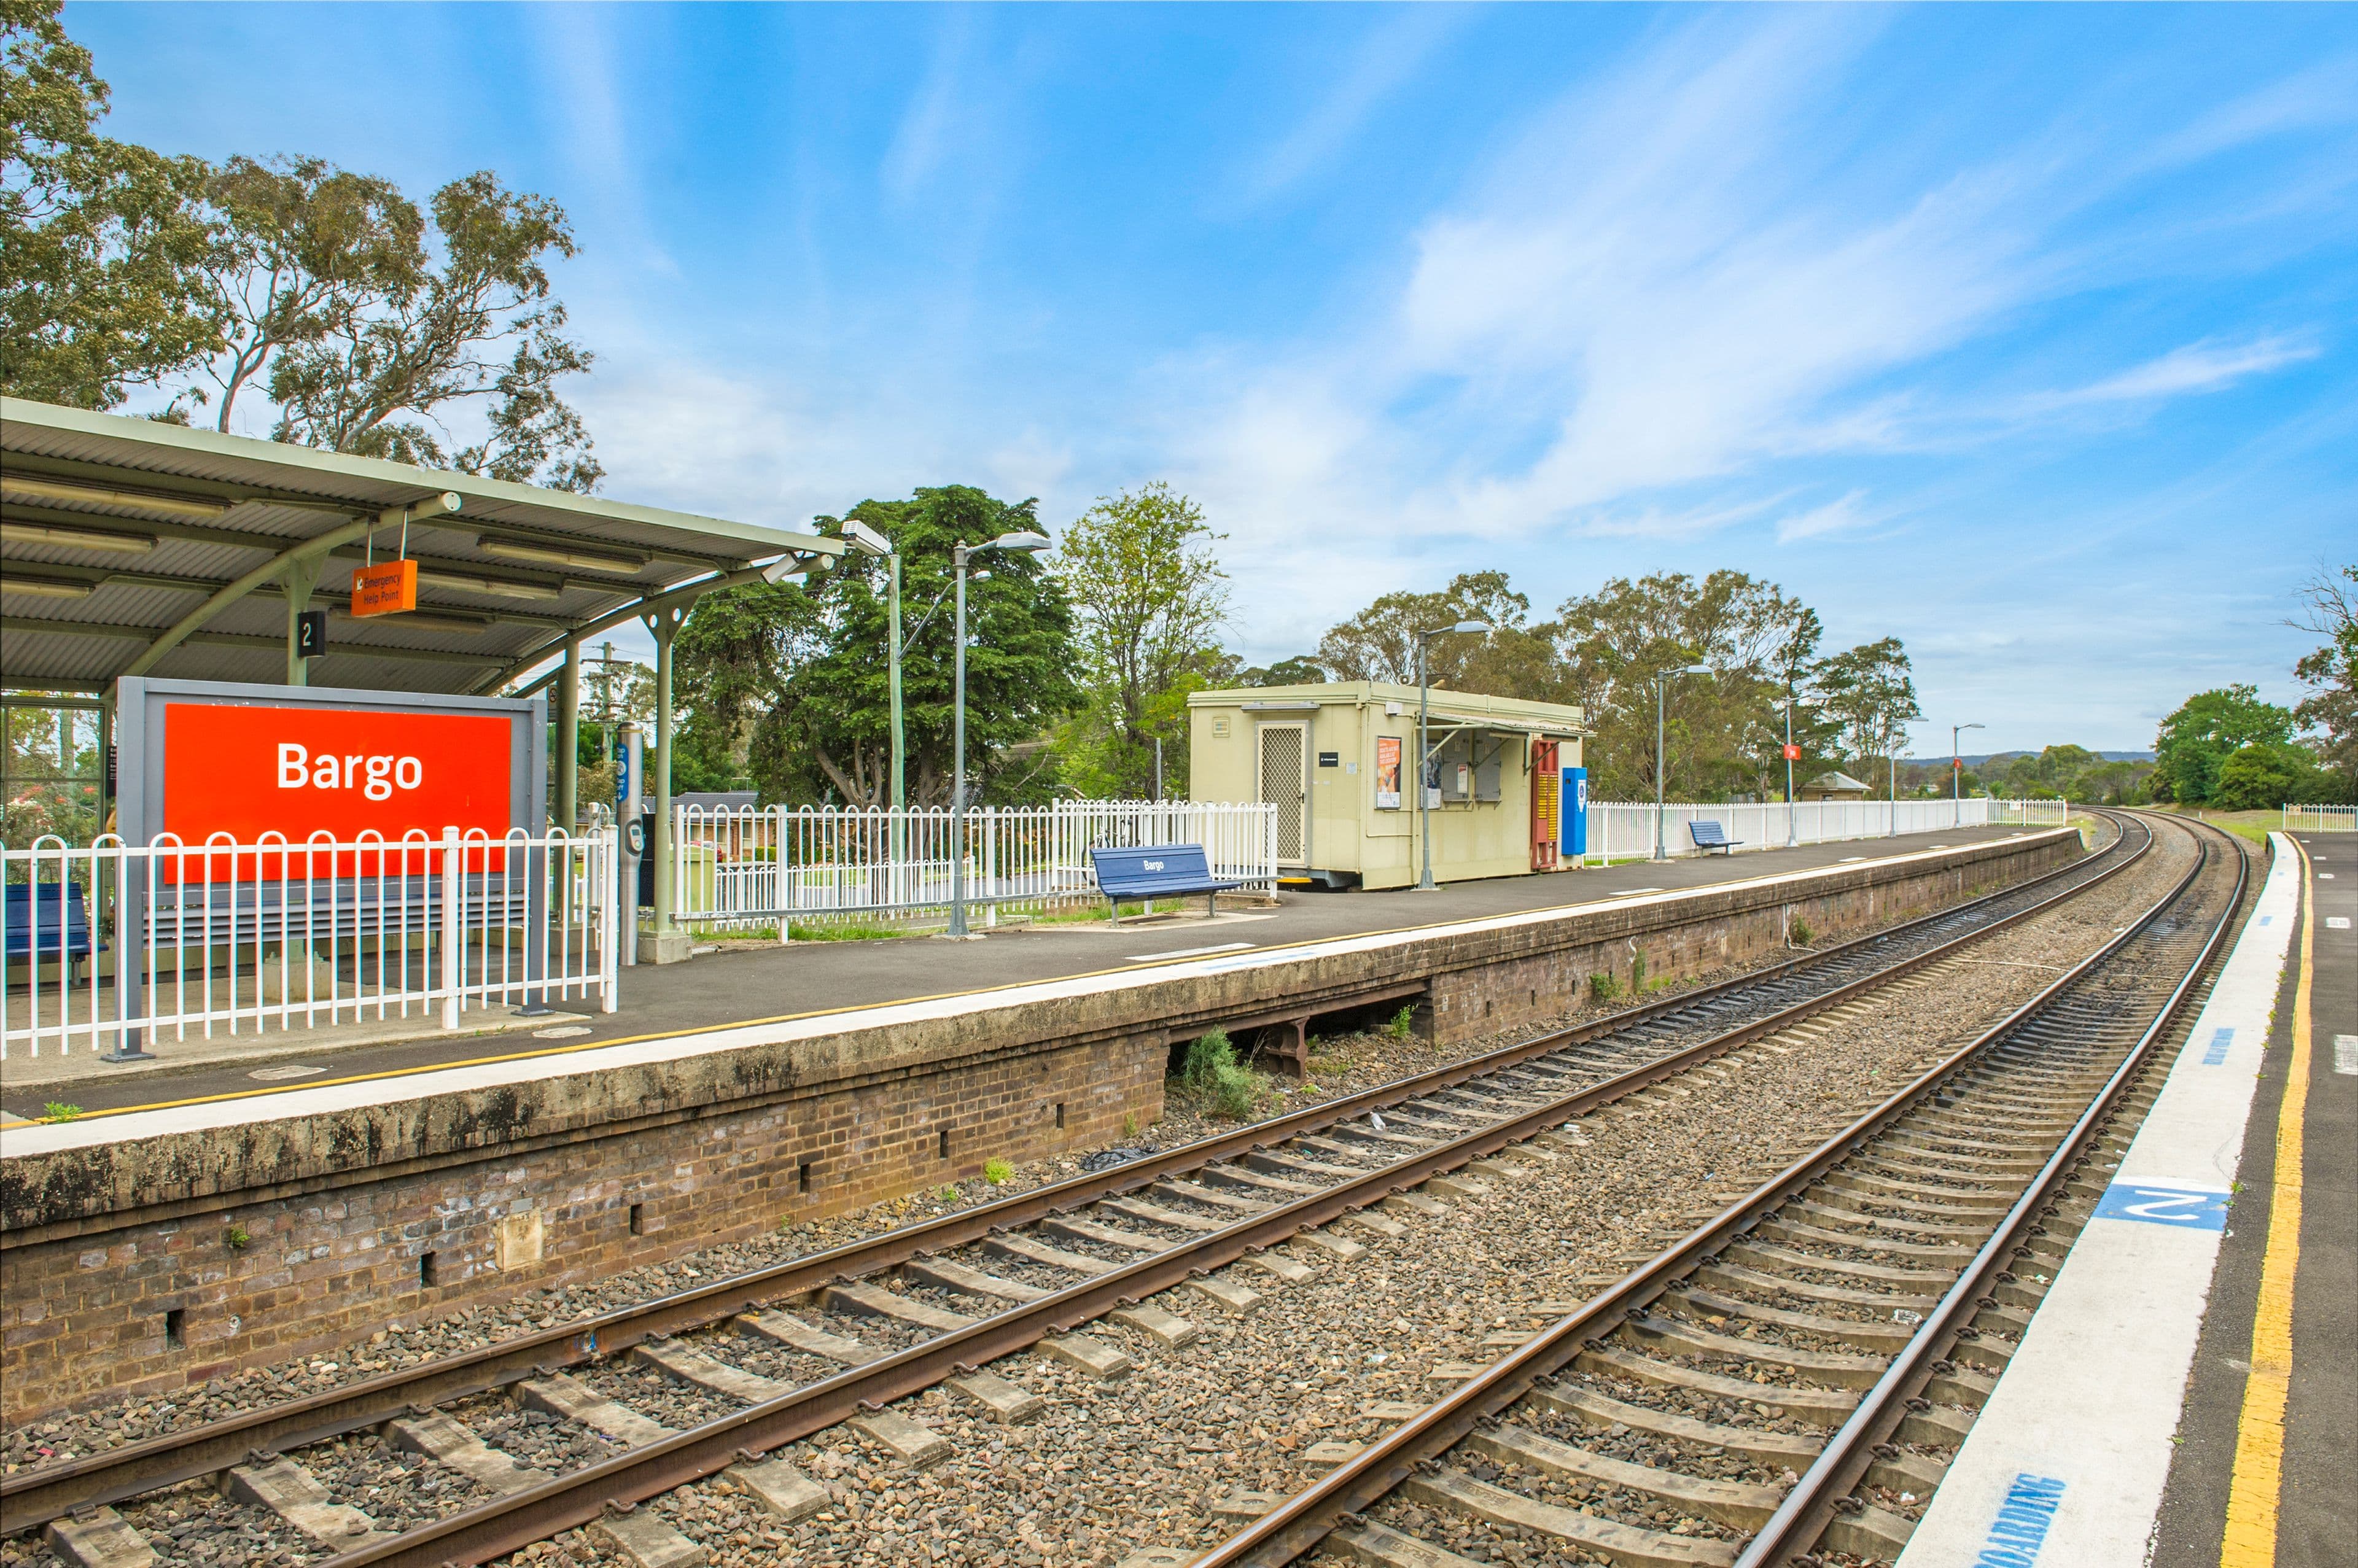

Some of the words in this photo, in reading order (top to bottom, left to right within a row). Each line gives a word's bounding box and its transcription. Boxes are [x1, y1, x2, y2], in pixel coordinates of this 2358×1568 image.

[364, 575, 401, 589] Emergency
[364, 593, 379, 605] Help
[381, 590, 399, 602] Point
[303, 622, 311, 646] 2
[278, 743, 422, 801] Bargo
[1143, 860, 1164, 872] Bargo
[1973, 1473, 2067, 1568] OARDING
